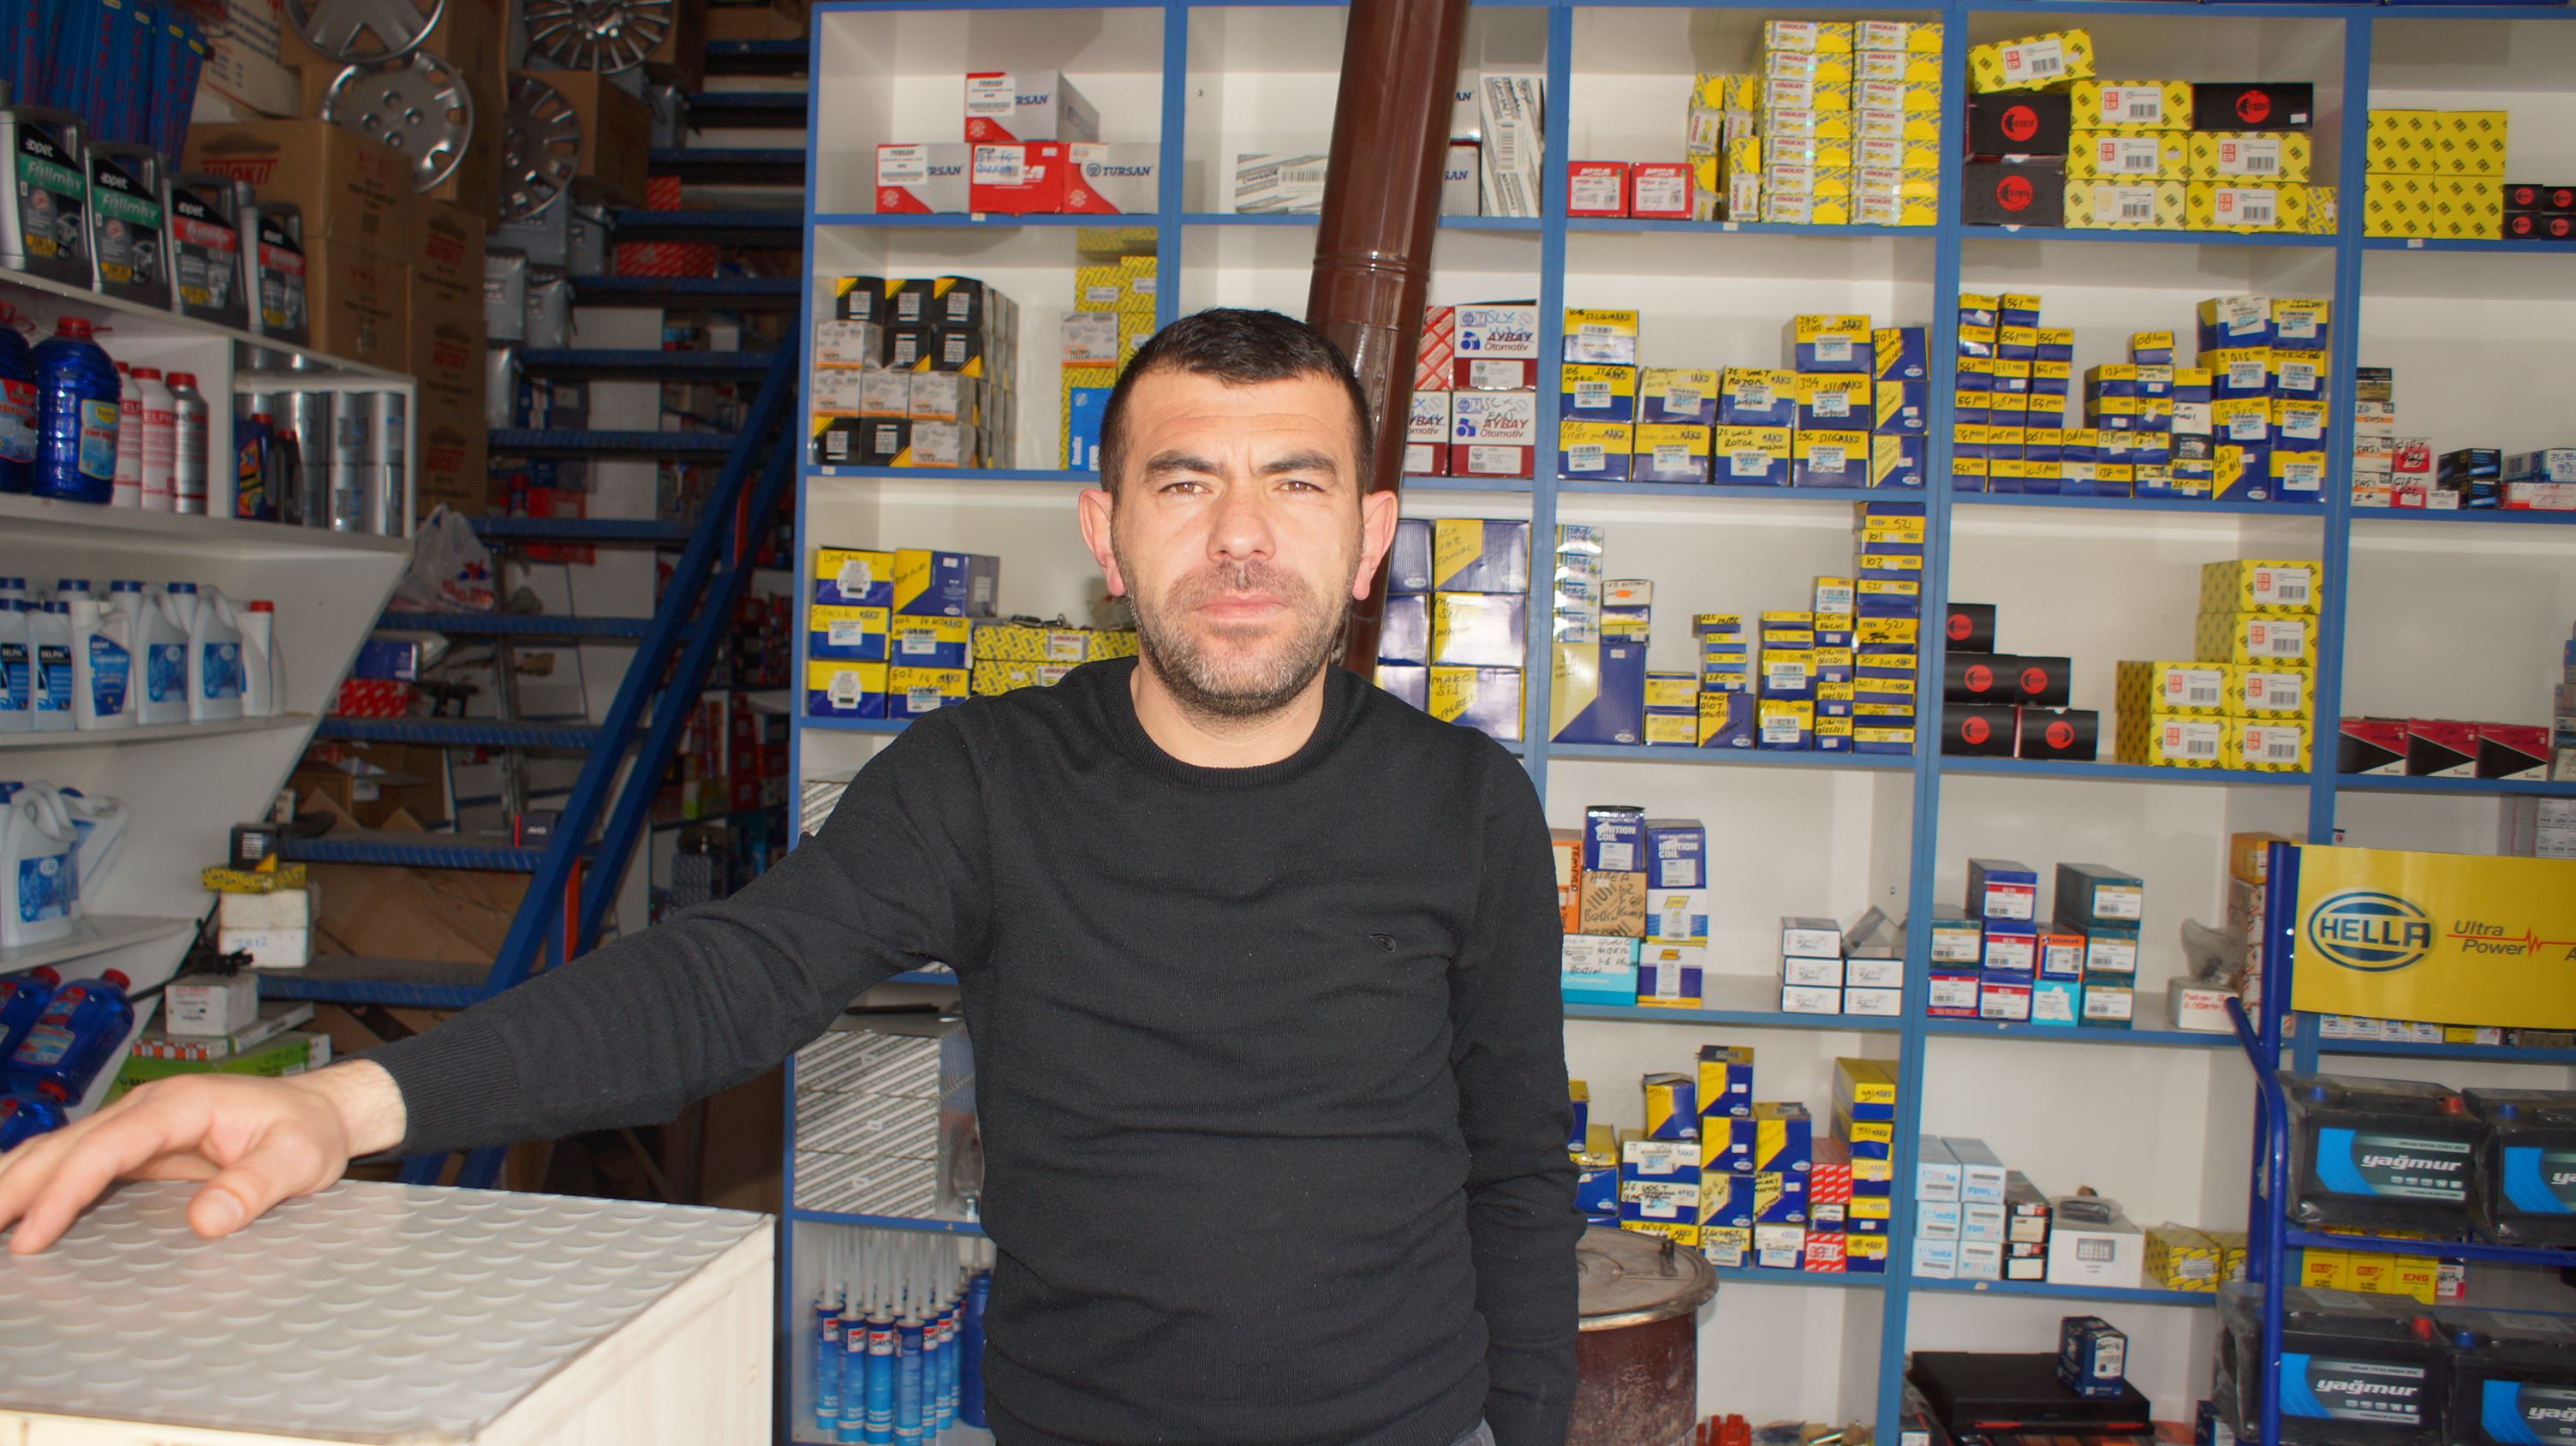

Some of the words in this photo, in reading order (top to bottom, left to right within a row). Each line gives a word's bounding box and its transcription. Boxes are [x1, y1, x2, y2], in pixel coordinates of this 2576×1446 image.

[1014, 94, 1049, 106] RSAN
[927, 166, 962, 176] RSAN
[1103, 165, 1152, 176] TURSAN
[1487, 332, 1533, 342] AYBAY
[1484, 343, 1528, 351] Otomotiv
[1771, 375, 1792, 385] MAKO
[1410, 416, 1445, 426] YBAY
[1482, 420, 1528, 429] AYBAY
[1480, 429, 1524, 438] Otomotiv
[1762, 434, 1783, 443] MAKO
[1893, 519, 1911, 529] 521
[1601, 825, 1637, 835] NITION
[1659, 842, 1697, 851] IGNITION
[2320, 917, 2430, 949] HELLA
[2454, 920, 2504, 936] Ultra
[2462, 939, 2526, 955] Power
[2361, 1153, 2462, 1172] yağmur
[2403, 1273, 2430, 1282] ENG
[2316, 1379, 2418, 1397] yağmur
[2526, 1404, 2576, 1421] yağ
